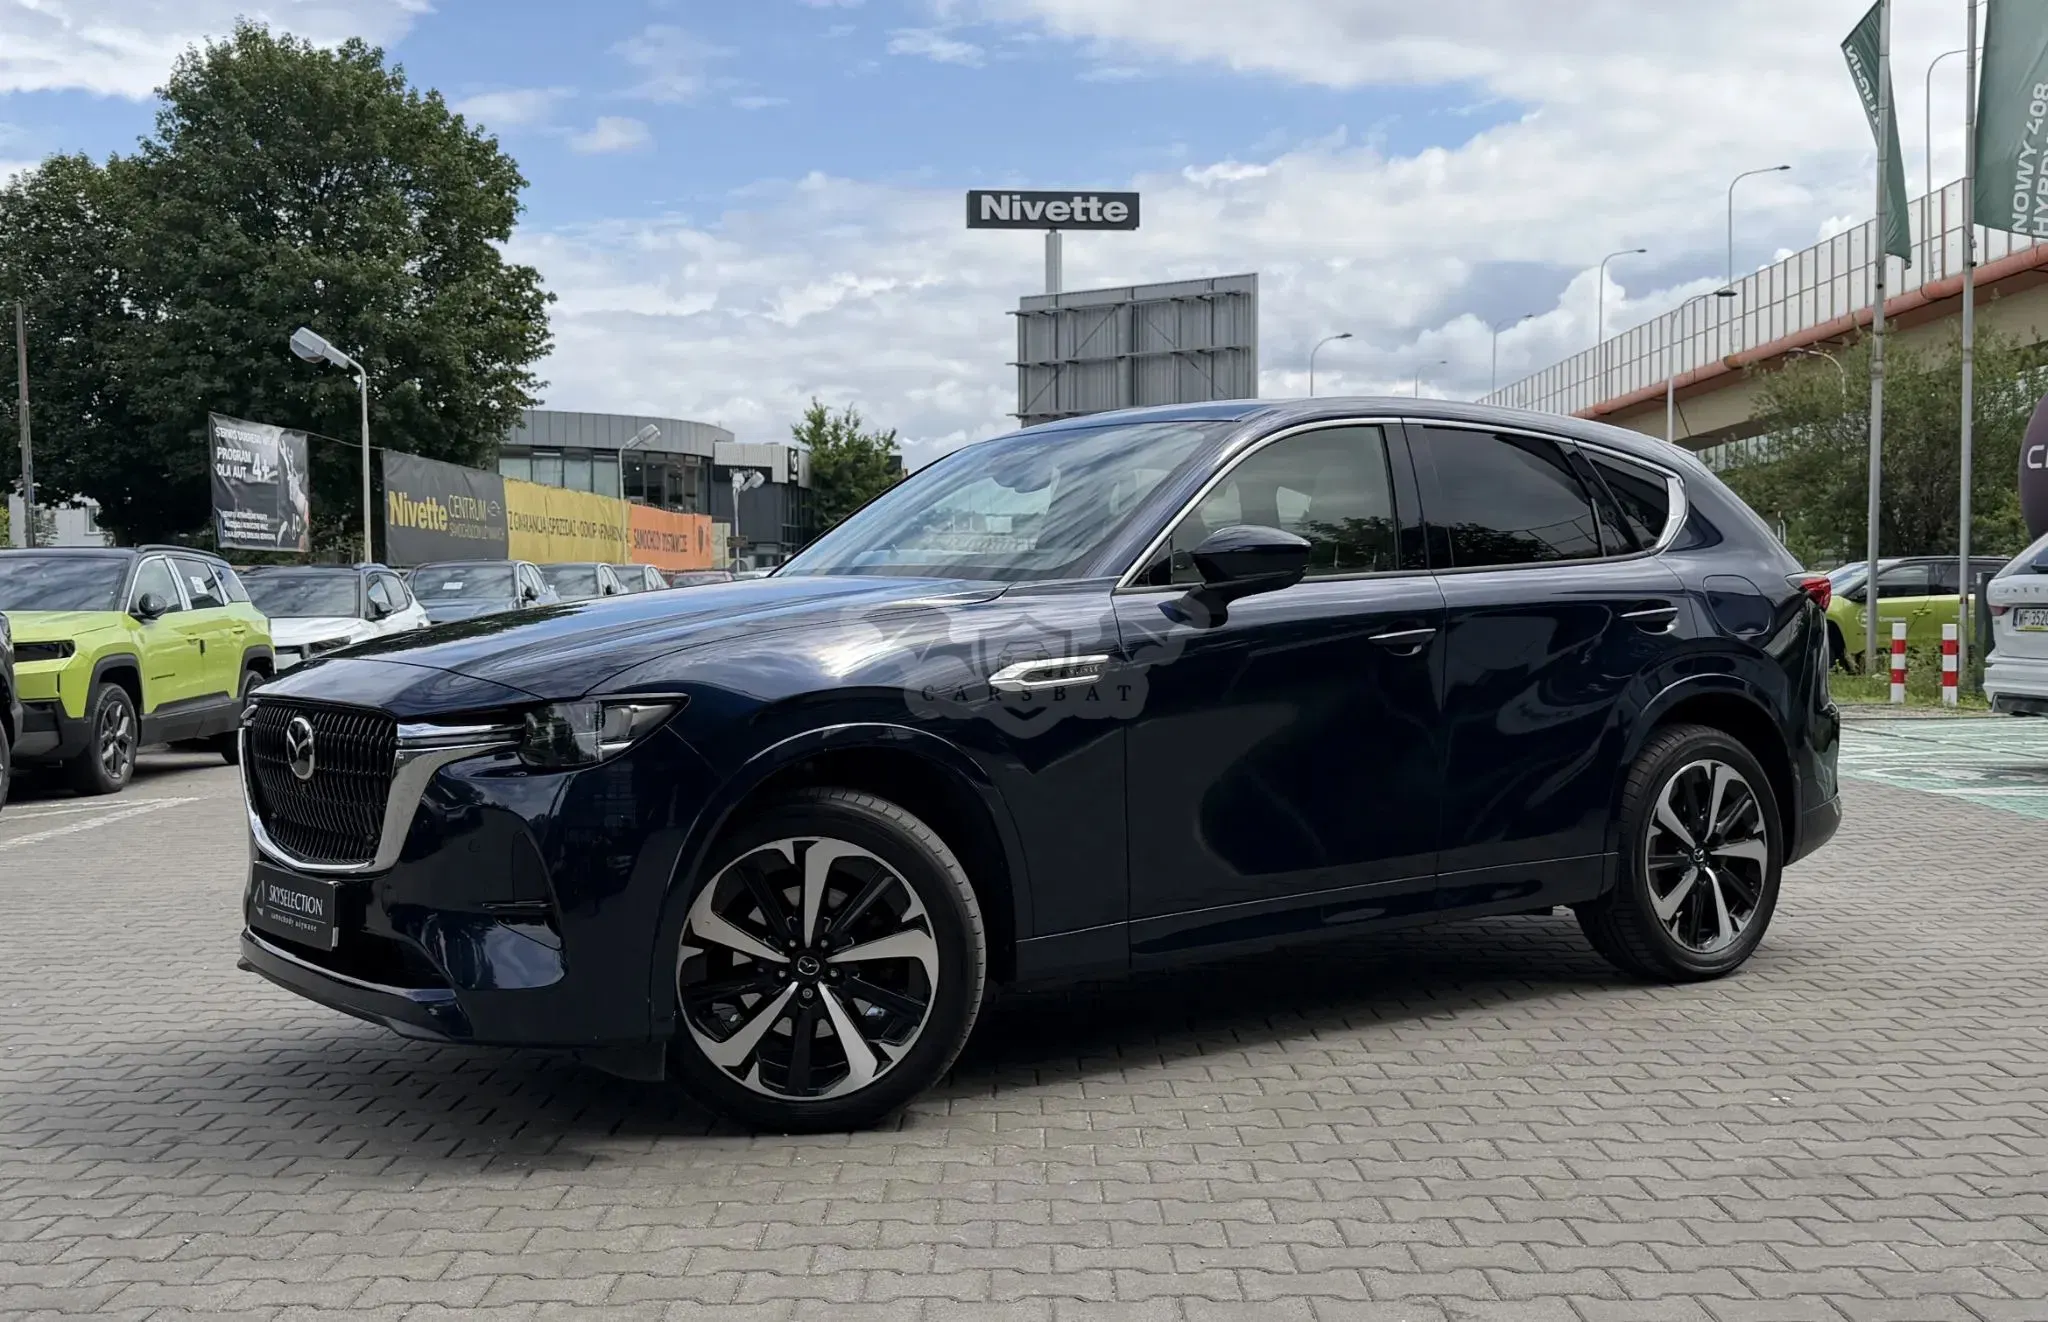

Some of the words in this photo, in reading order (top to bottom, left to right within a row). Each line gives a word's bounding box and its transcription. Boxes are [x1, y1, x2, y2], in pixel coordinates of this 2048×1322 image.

[2011, 140, 2038, 233] NOWY
[2026, 82, 2048, 135] 408
[980, 194, 1129, 223] Nivette
[216, 446, 252, 463] PROGRAM
[2027, 444, 2048, 469] C
[216, 463, 231, 477] DLA
[232, 465, 247, 480] AUT
[388, 490, 448, 532] Nivette
[448, 494, 487, 521] CENTRUM
[268, 884, 323, 916] SKYSELECTION
